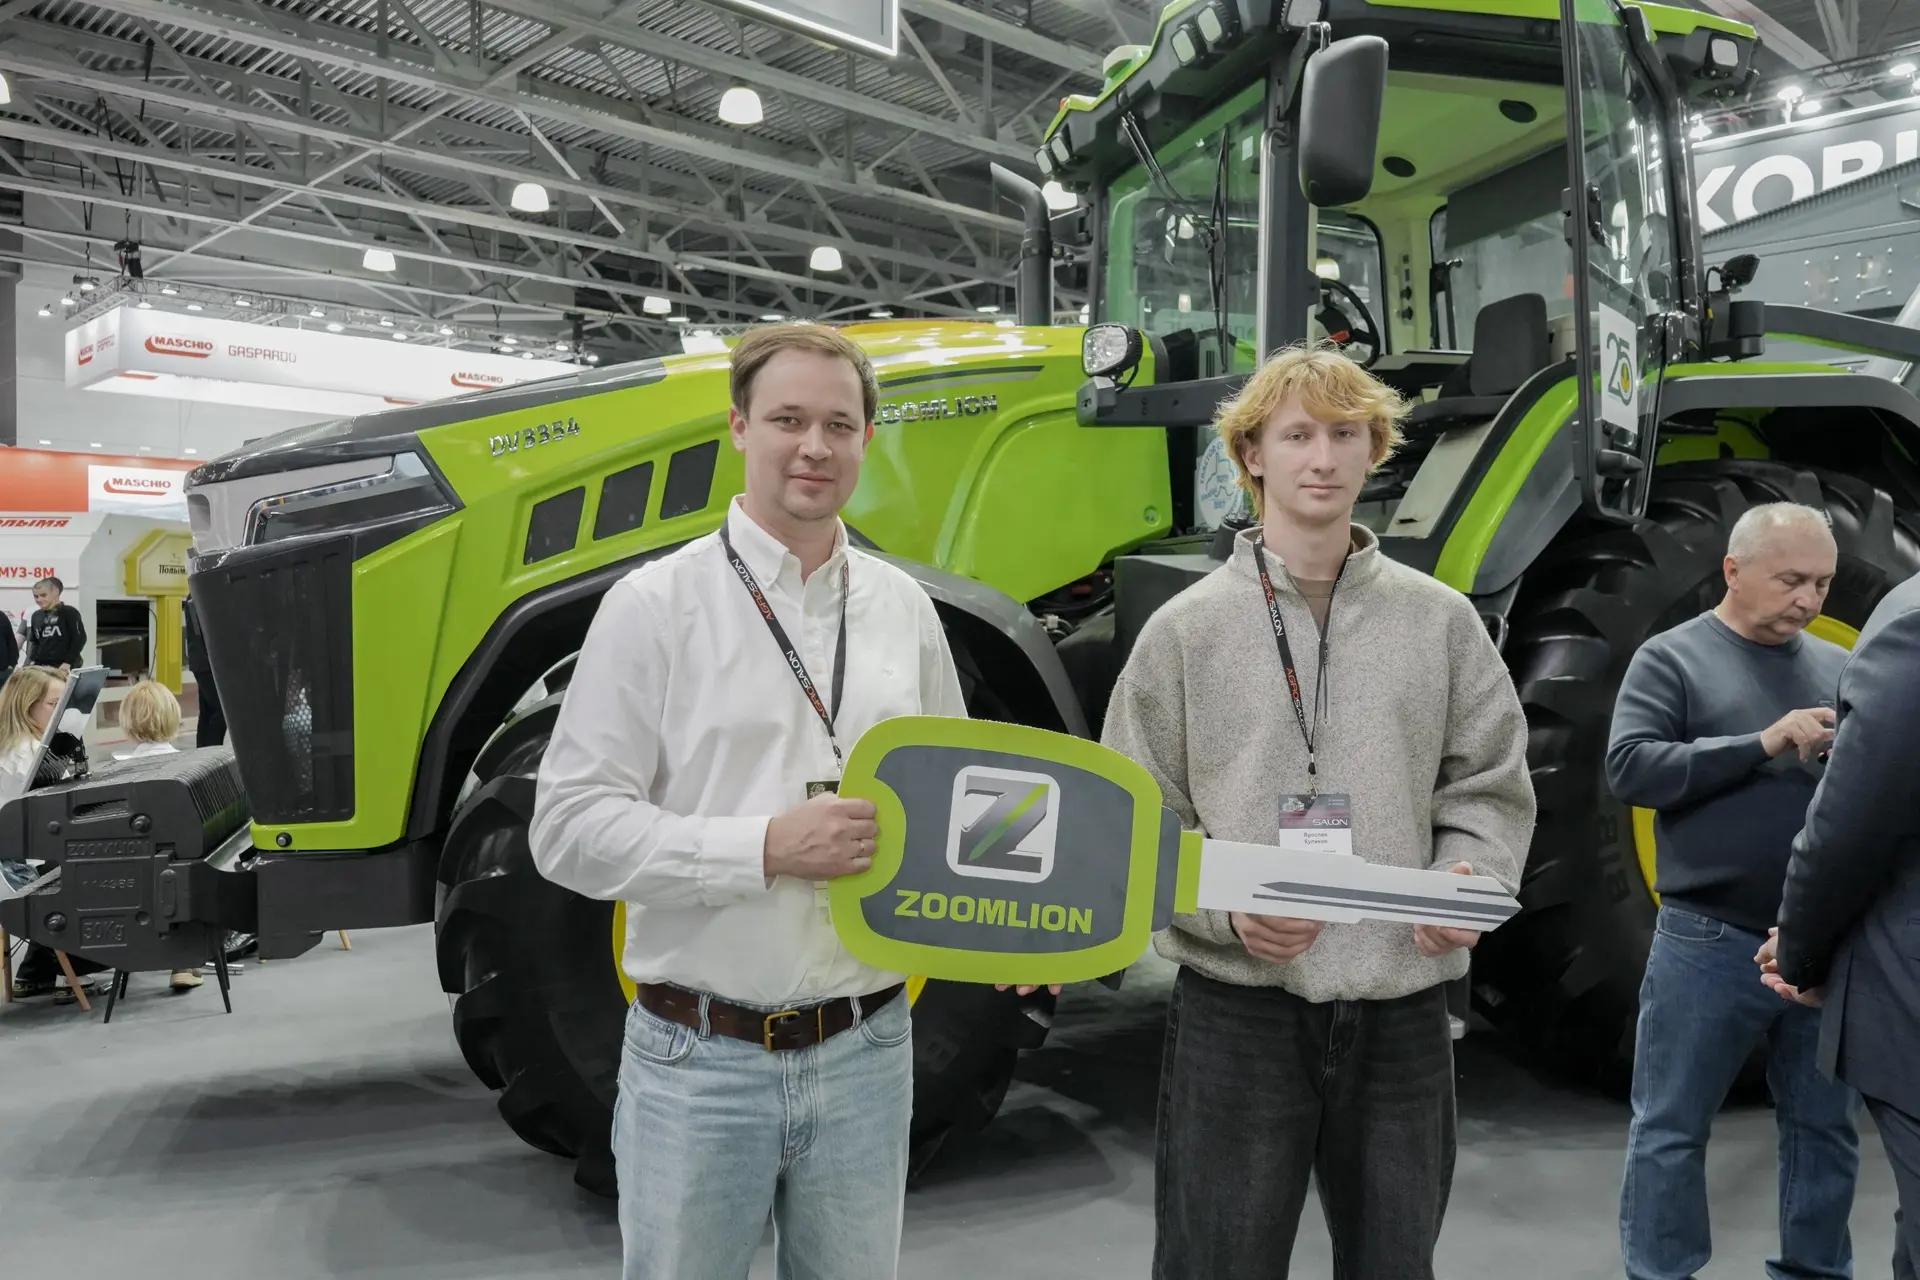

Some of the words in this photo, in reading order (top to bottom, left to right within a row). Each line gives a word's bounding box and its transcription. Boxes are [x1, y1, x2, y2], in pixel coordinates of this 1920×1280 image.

[154, 335, 213, 350] MASCHIO
[458, 371, 504, 384] MASCHIO
[488, 416, 580, 457] DV3354
[112, 477, 171, 489] MASCHIO
[159, 564, 188, 576] Полым
[731, 557, 775, 621] AGROSALON
[1260, 571, 1284, 638] AGROSALON
[786, 649, 829, 720] AGROSALON
[1312, 818, 1348, 826] SALON
[894, 889, 1093, 935] ZOOMLION
